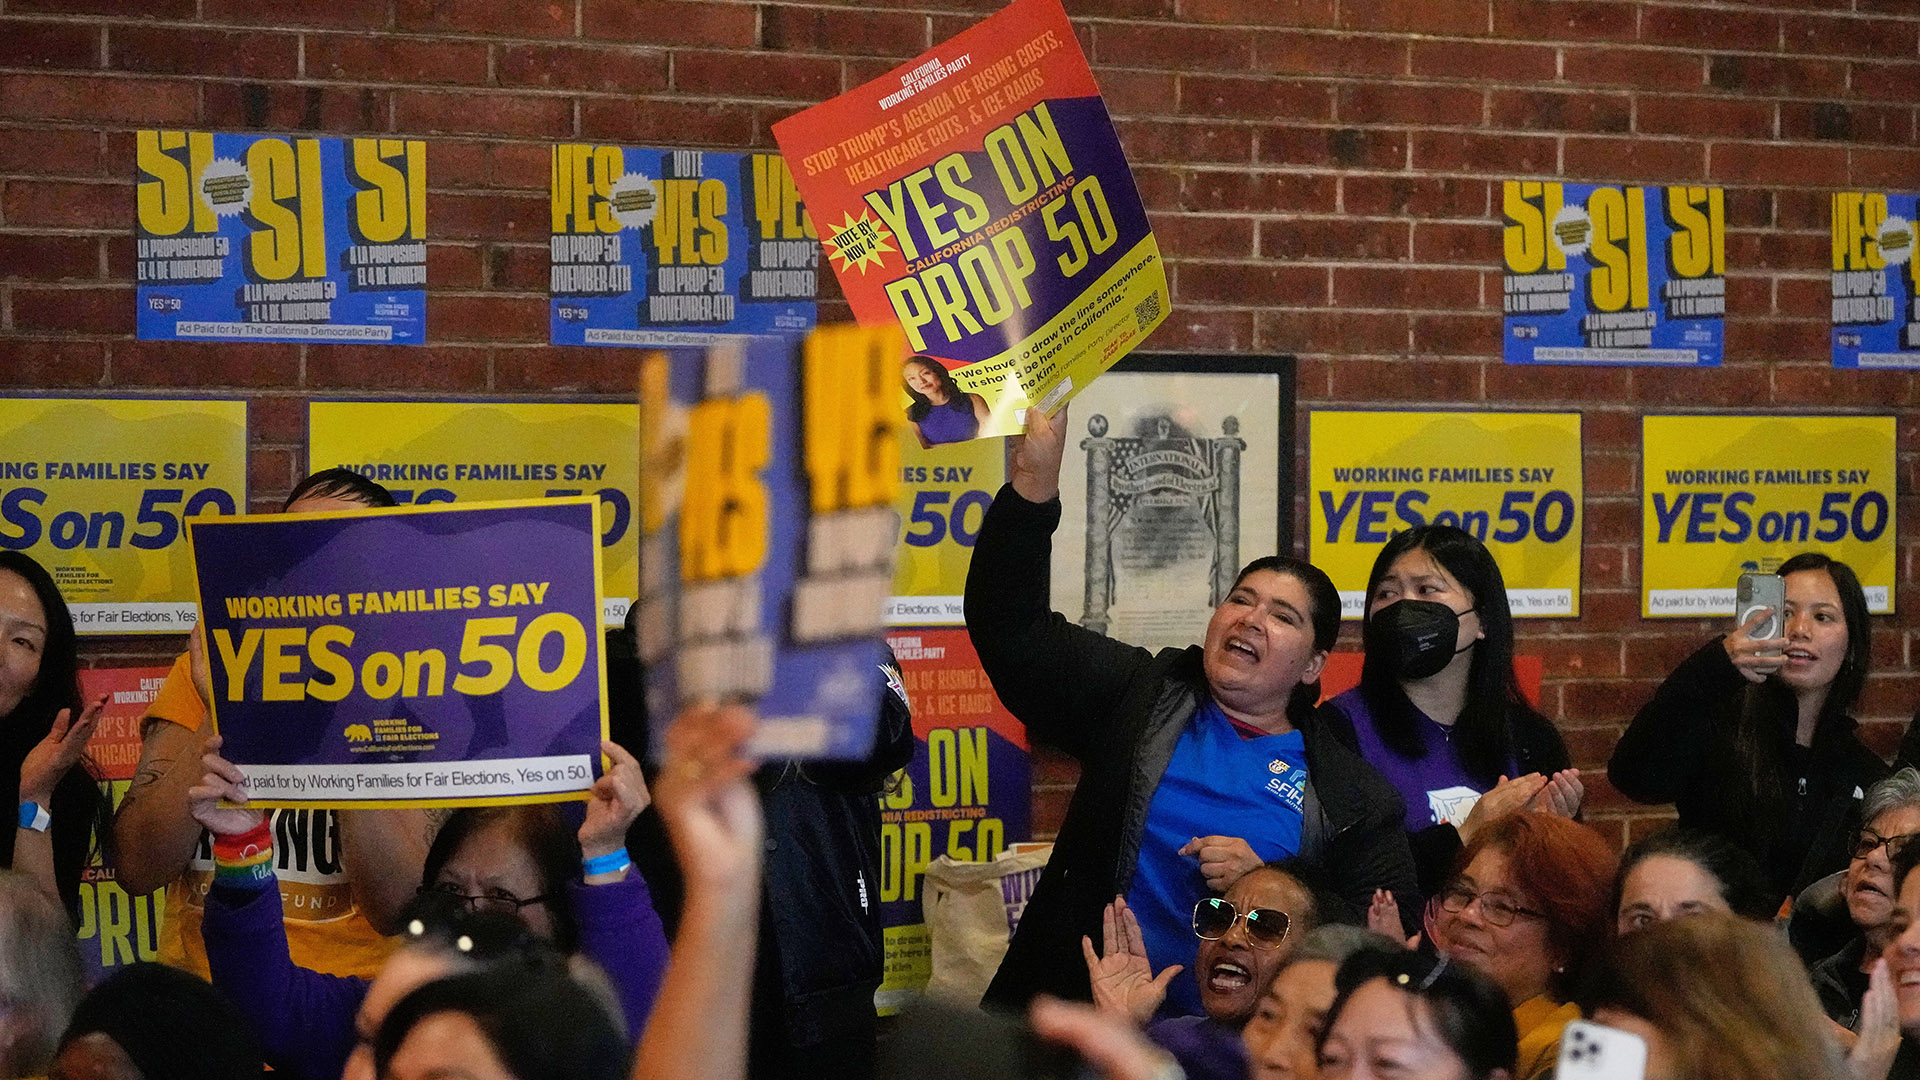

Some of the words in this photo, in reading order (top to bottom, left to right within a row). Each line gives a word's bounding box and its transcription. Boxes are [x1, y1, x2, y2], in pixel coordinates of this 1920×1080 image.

[878, 85, 915, 111] WORKING
[914, 67, 948, 93] FAMILIES
[946, 53, 971, 75] PARTY
[901, 57, 942, 87] CALIFORNIA
[802, 146, 839, 176] STOP
[839, 118, 902, 161] TRUMP'S
[902, 92, 954, 132] AGENDA
[953, 83, 972, 105] OF
[971, 56, 1018, 94] RISING
[1018, 30, 1064, 66] COSTS,
[844, 137, 929, 185] HEALTHCARE
[926, 116, 970, 144] CUTS,
[969, 105, 983, 125] &
[981, 89, 1006, 118] ICE
[1007, 68, 1045, 100] RAIDS
[673, 150, 703, 178] VOTE
[551, 144, 624, 233] YES
[864, 153, 989, 261] YES
[984, 101, 1074, 206] ON
[650, 179, 729, 264] YES
[833, 227, 860, 249] VOTE
[857, 219, 872, 236] BY
[905, 232, 985, 275] CALIFORNIA
[986, 175, 1077, 238] REDISTRICTING
[216, 237, 229, 256] 50
[551, 236, 568, 263] ON
[570, 236, 603, 262] PROP
[604, 236, 621, 262] 50
[760, 241, 778, 268] ON
[779, 241, 810, 267] PROP
[844, 242, 866, 262] NOV
[138, 260, 148, 280] EL
[157, 260, 169, 279] DE
[170, 259, 223, 278] NOVIEMBRE
[884, 226, 1036, 352] PROP
[1040, 175, 1118, 278] 50
[324, 281, 337, 300] 50
[608, 265, 631, 291] 4TH
[658, 267, 675, 293] ON
[676, 267, 708, 292] PROP
[708, 267, 724, 292] 50
[752, 271, 814, 297] NOVEMBER
[282, 302, 331, 321] NOVIEMBRE
[650, 296, 712, 322] NOVEMBER
[713, 296, 735, 320] 4TH
[985, 358, 1016, 373] have
[1032, 331, 1058, 354] draw
[1059, 316, 1076, 333] the
[1077, 301, 1095, 319] line
[1097, 254, 1156, 304] somewhere.
[179, 324, 192, 334] Ad
[194, 325, 214, 334] Paid
[217, 325, 229, 334] for
[231, 325, 242, 336] by
[245, 325, 262, 335] The
[264, 326, 308, 337] California
[311, 328, 361, 338] Democratic
[364, 329, 389, 341] Party
[587, 331, 599, 340] Ad
[602, 332, 621, 341] Paid
[650, 333, 664, 343] The
[667, 333, 708, 344] California
[968, 380, 978, 389] It
[1024, 361, 1038, 374] be
[1039, 342, 1062, 364] here
[1063, 334, 1073, 346] in
[1036, 362, 1056, 381] Kim
[45, 463, 157, 480] FAMILIES
[163, 463, 209, 480] SAY
[454, 464, 557, 481] FAMILIES
[563, 464, 607, 480] SAY
[933, 467, 973, 482] SAY
[1334, 468, 1423, 482] WORKING
[1429, 468, 1514, 482] FAMILIES
[1519, 468, 1554, 483] SAY
[1666, 470, 1749, 484] WORKING
[1754, 470, 1832, 484] FAMILIES
[1837, 470, 1869, 484] SAY
[905, 490, 994, 547] 50
[1319, 490, 1430, 543] YES
[1493, 490, 1575, 543] 50
[1652, 492, 1756, 543] YES
[1758, 511, 1811, 543] on
[1814, 491, 1889, 543] 50
[50, 511, 125, 550] on
[225, 592, 342, 619] WORKING
[348, 586, 481, 615] FAMILIES
[489, 582, 550, 607] SAY
[81, 611, 94, 622] for
[98, 611, 118, 622] Fair
[122, 610, 173, 624] Elections,
[213, 624, 355, 702] YES
[361, 649, 446, 700] on
[452, 612, 588, 696] 50
[921, 671, 935, 690] OF
[938, 669, 975, 690] RISING
[939, 694, 955, 715] ICE
[959, 694, 992, 715] RAIDS
[375, 726, 406, 734] FAMILIES
[400, 732, 439, 741] ELECTIONS
[254, 774, 275, 791] paid
[277, 774, 290, 788] for
[293, 774, 307, 791] by
[308, 774, 354, 791] Working
[357, 773, 404, 788] Families
[406, 773, 422, 787] for
[425, 772, 449, 786] Fair
[452, 770, 514, 786] Elections,
[517, 768, 543, 782] Yes
[546, 769, 564, 781] on
[568, 765, 590, 779] 50.
[928, 727, 989, 809] ON
[1268, 778, 1304, 805] SFIH
[904, 807, 986, 821] REDISTRICTING
